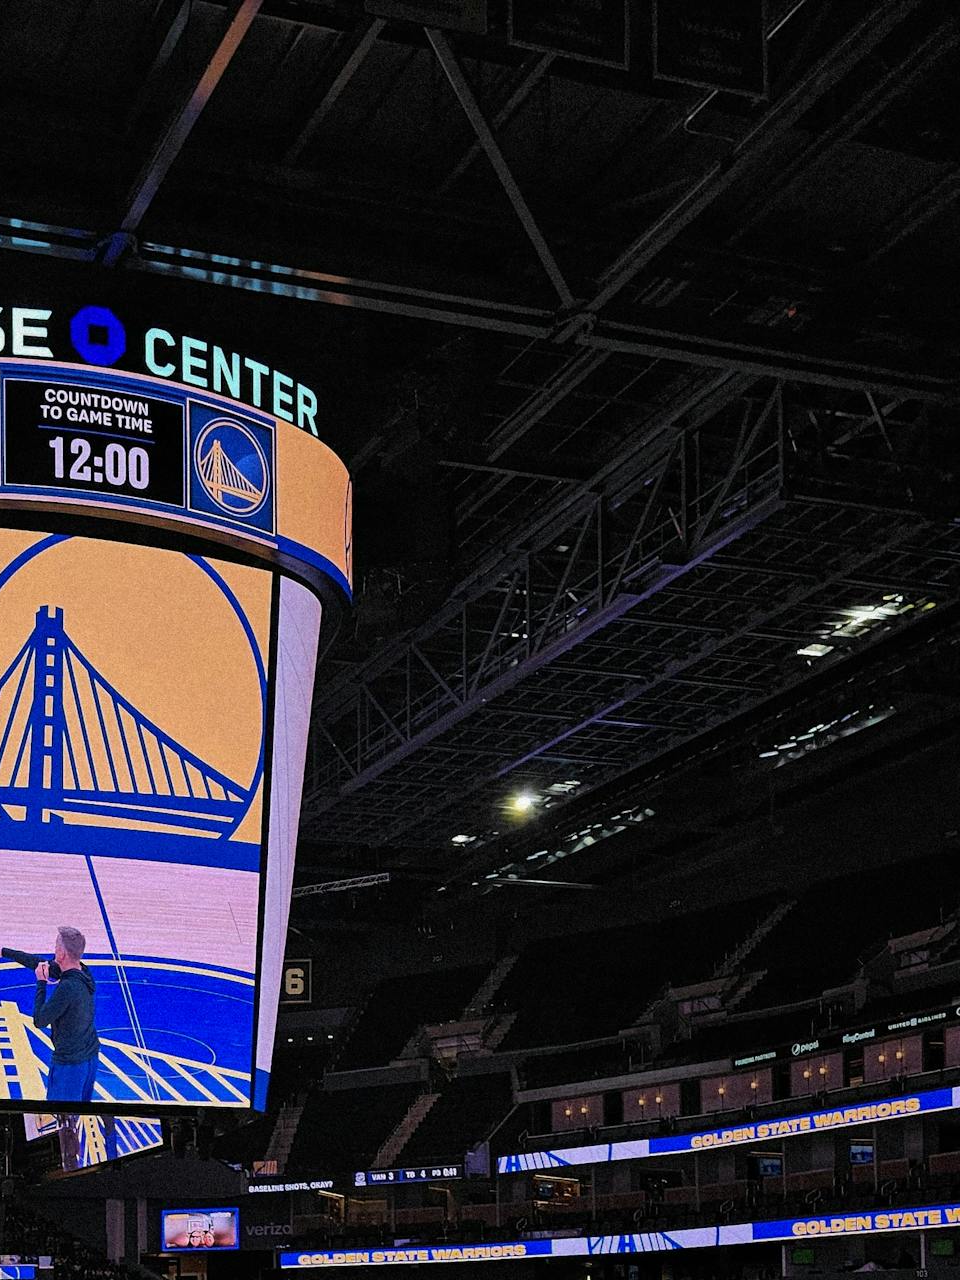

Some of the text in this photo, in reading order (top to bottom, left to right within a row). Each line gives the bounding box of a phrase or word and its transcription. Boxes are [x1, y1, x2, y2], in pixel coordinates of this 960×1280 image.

[144, 327, 319, 437] CENTER
[44, 388, 149, 417] COUNTDOWN
[40, 404, 153, 434] TO GAME TIME
[48, 435, 150, 490] 12:00
[285, 967, 305, 995] 6
[800, 1040, 820, 1055] pepsi
[690, 1098, 921, 1149] GOLDEN STATE WARRIORS
[248, 1183, 285, 1194] BASELINE
[309, 1179, 334, 1191] OKAY?
[371, 1172, 386, 1181] VAN
[791, 1215, 873, 1236] GOLDEN
[874, 1209, 942, 1229] STATE
[297, 1244, 527, 1265] GOLDEN STATE WARRIORS
